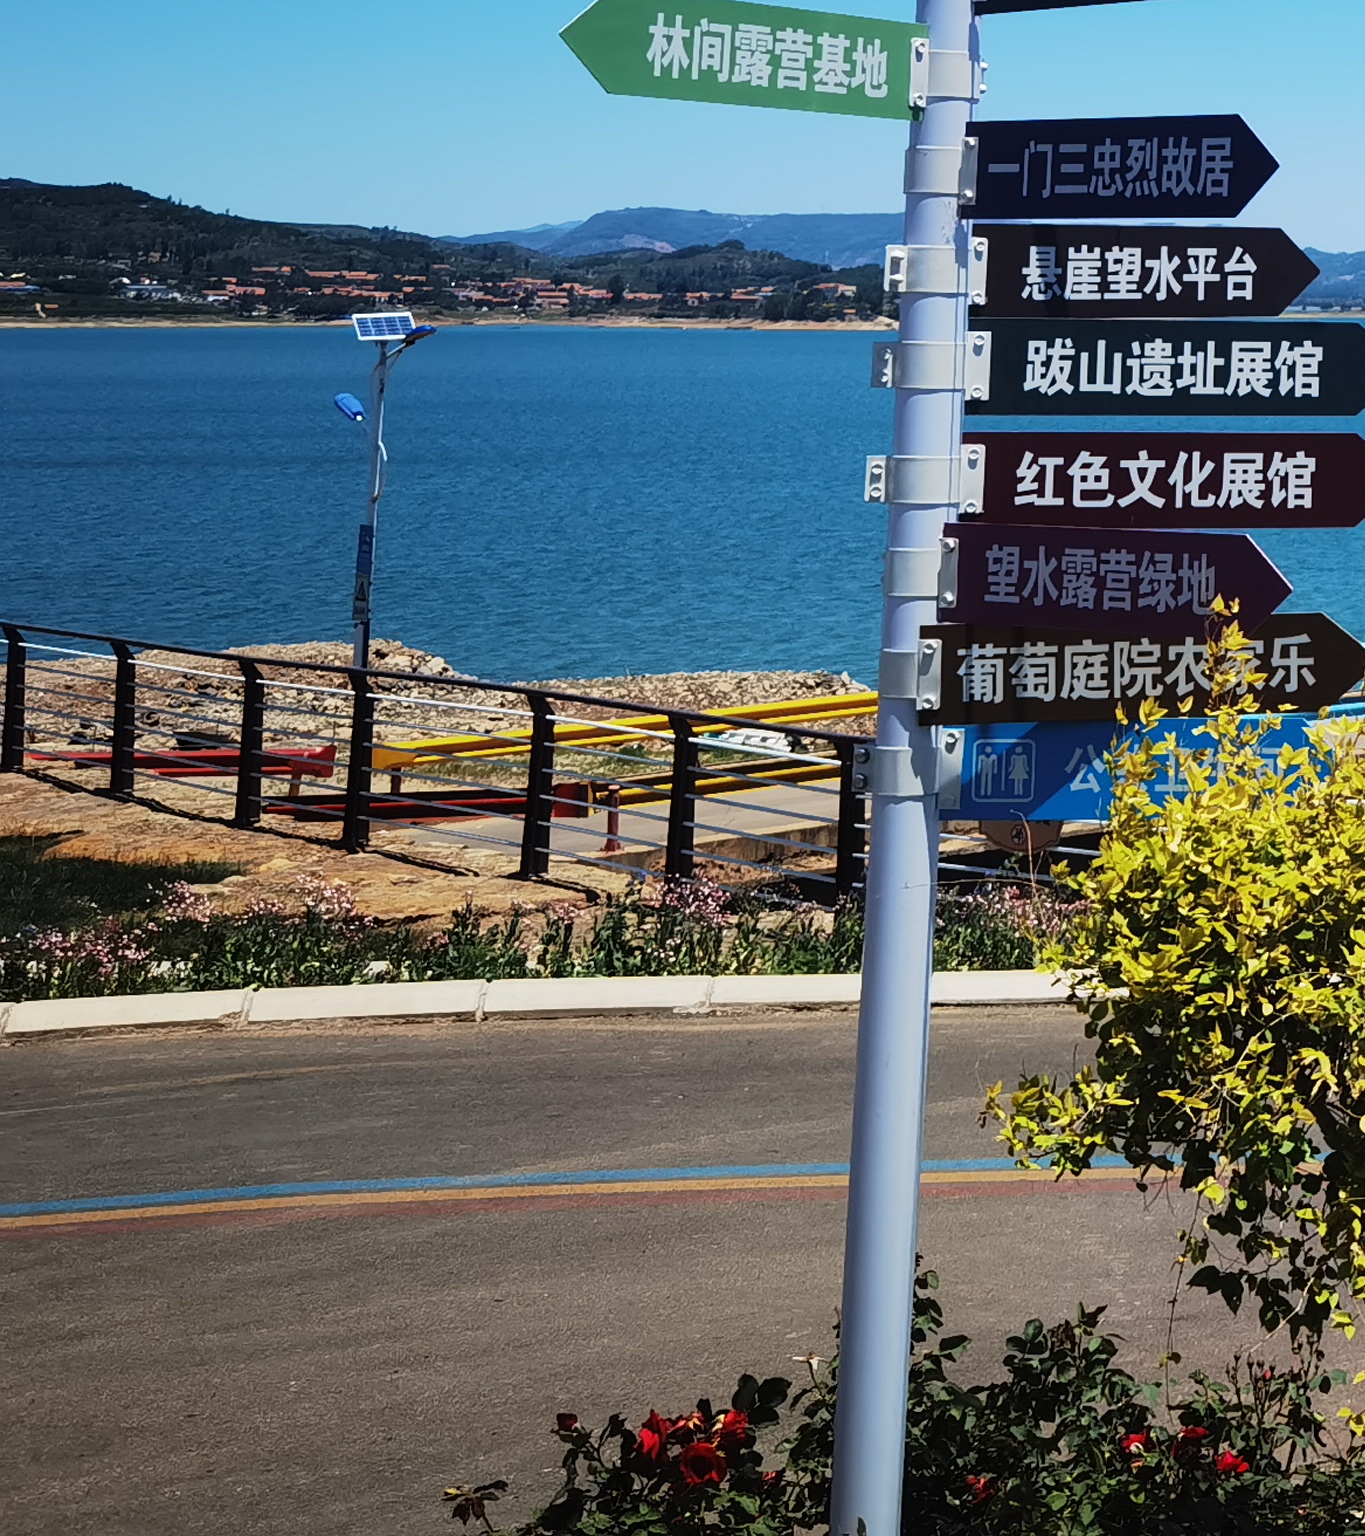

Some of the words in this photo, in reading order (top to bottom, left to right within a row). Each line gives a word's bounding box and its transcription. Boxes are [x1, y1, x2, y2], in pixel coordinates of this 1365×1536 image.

[646, 12, 888, 98] 林间露营基地
[987, 136, 1234, 200] 一门三忠烈故居
[1021, 245, 1258, 302] 悬崖望水平台
[1025, 339, 1323, 399] 跋山遗址展馆
[1014, 450, 1317, 510] 红色文化展馆
[984, 544, 1216, 615] 望水露营绿地
[956, 633, 1316, 705] 葡萄庭院农家乐
